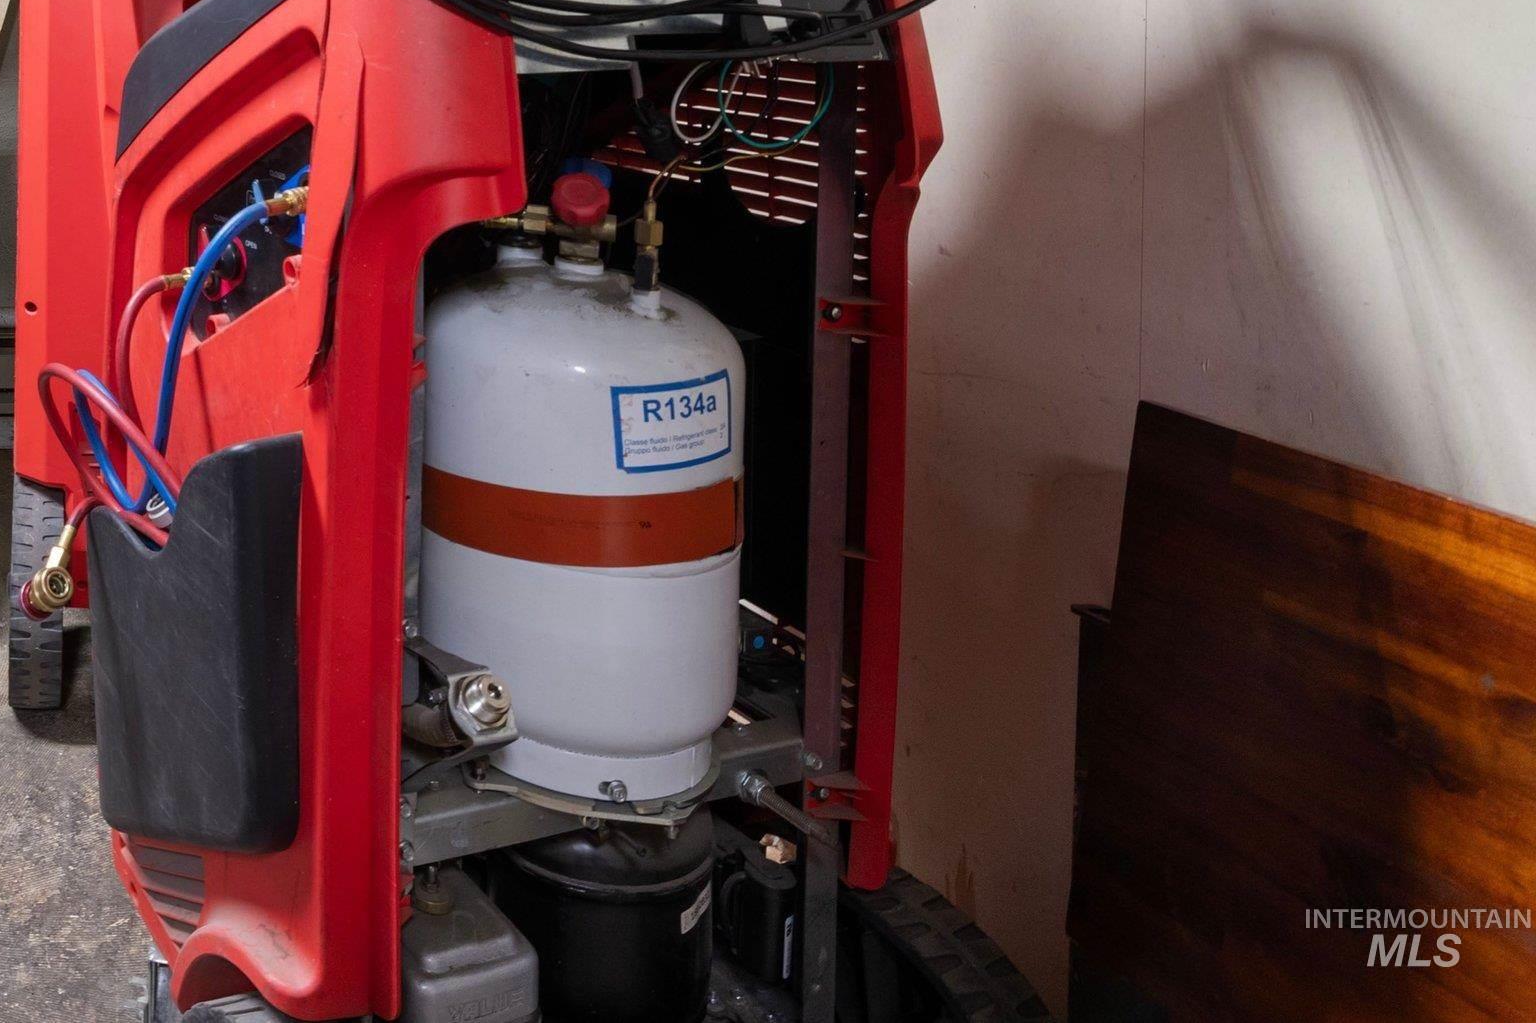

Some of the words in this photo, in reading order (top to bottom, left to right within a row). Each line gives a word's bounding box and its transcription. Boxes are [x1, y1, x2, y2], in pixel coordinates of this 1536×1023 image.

[244, 239, 258, 250] OPEN
[642, 392, 717, 423] R134a
[624, 438, 648, 446] Classe
[650, 436, 668, 444] fluido
[673, 430, 704, 443] Refrigerant
[624, 446, 651, 456] Gruppo
[652, 444, 670, 453] fluido
[675, 443, 688, 451] Gas
